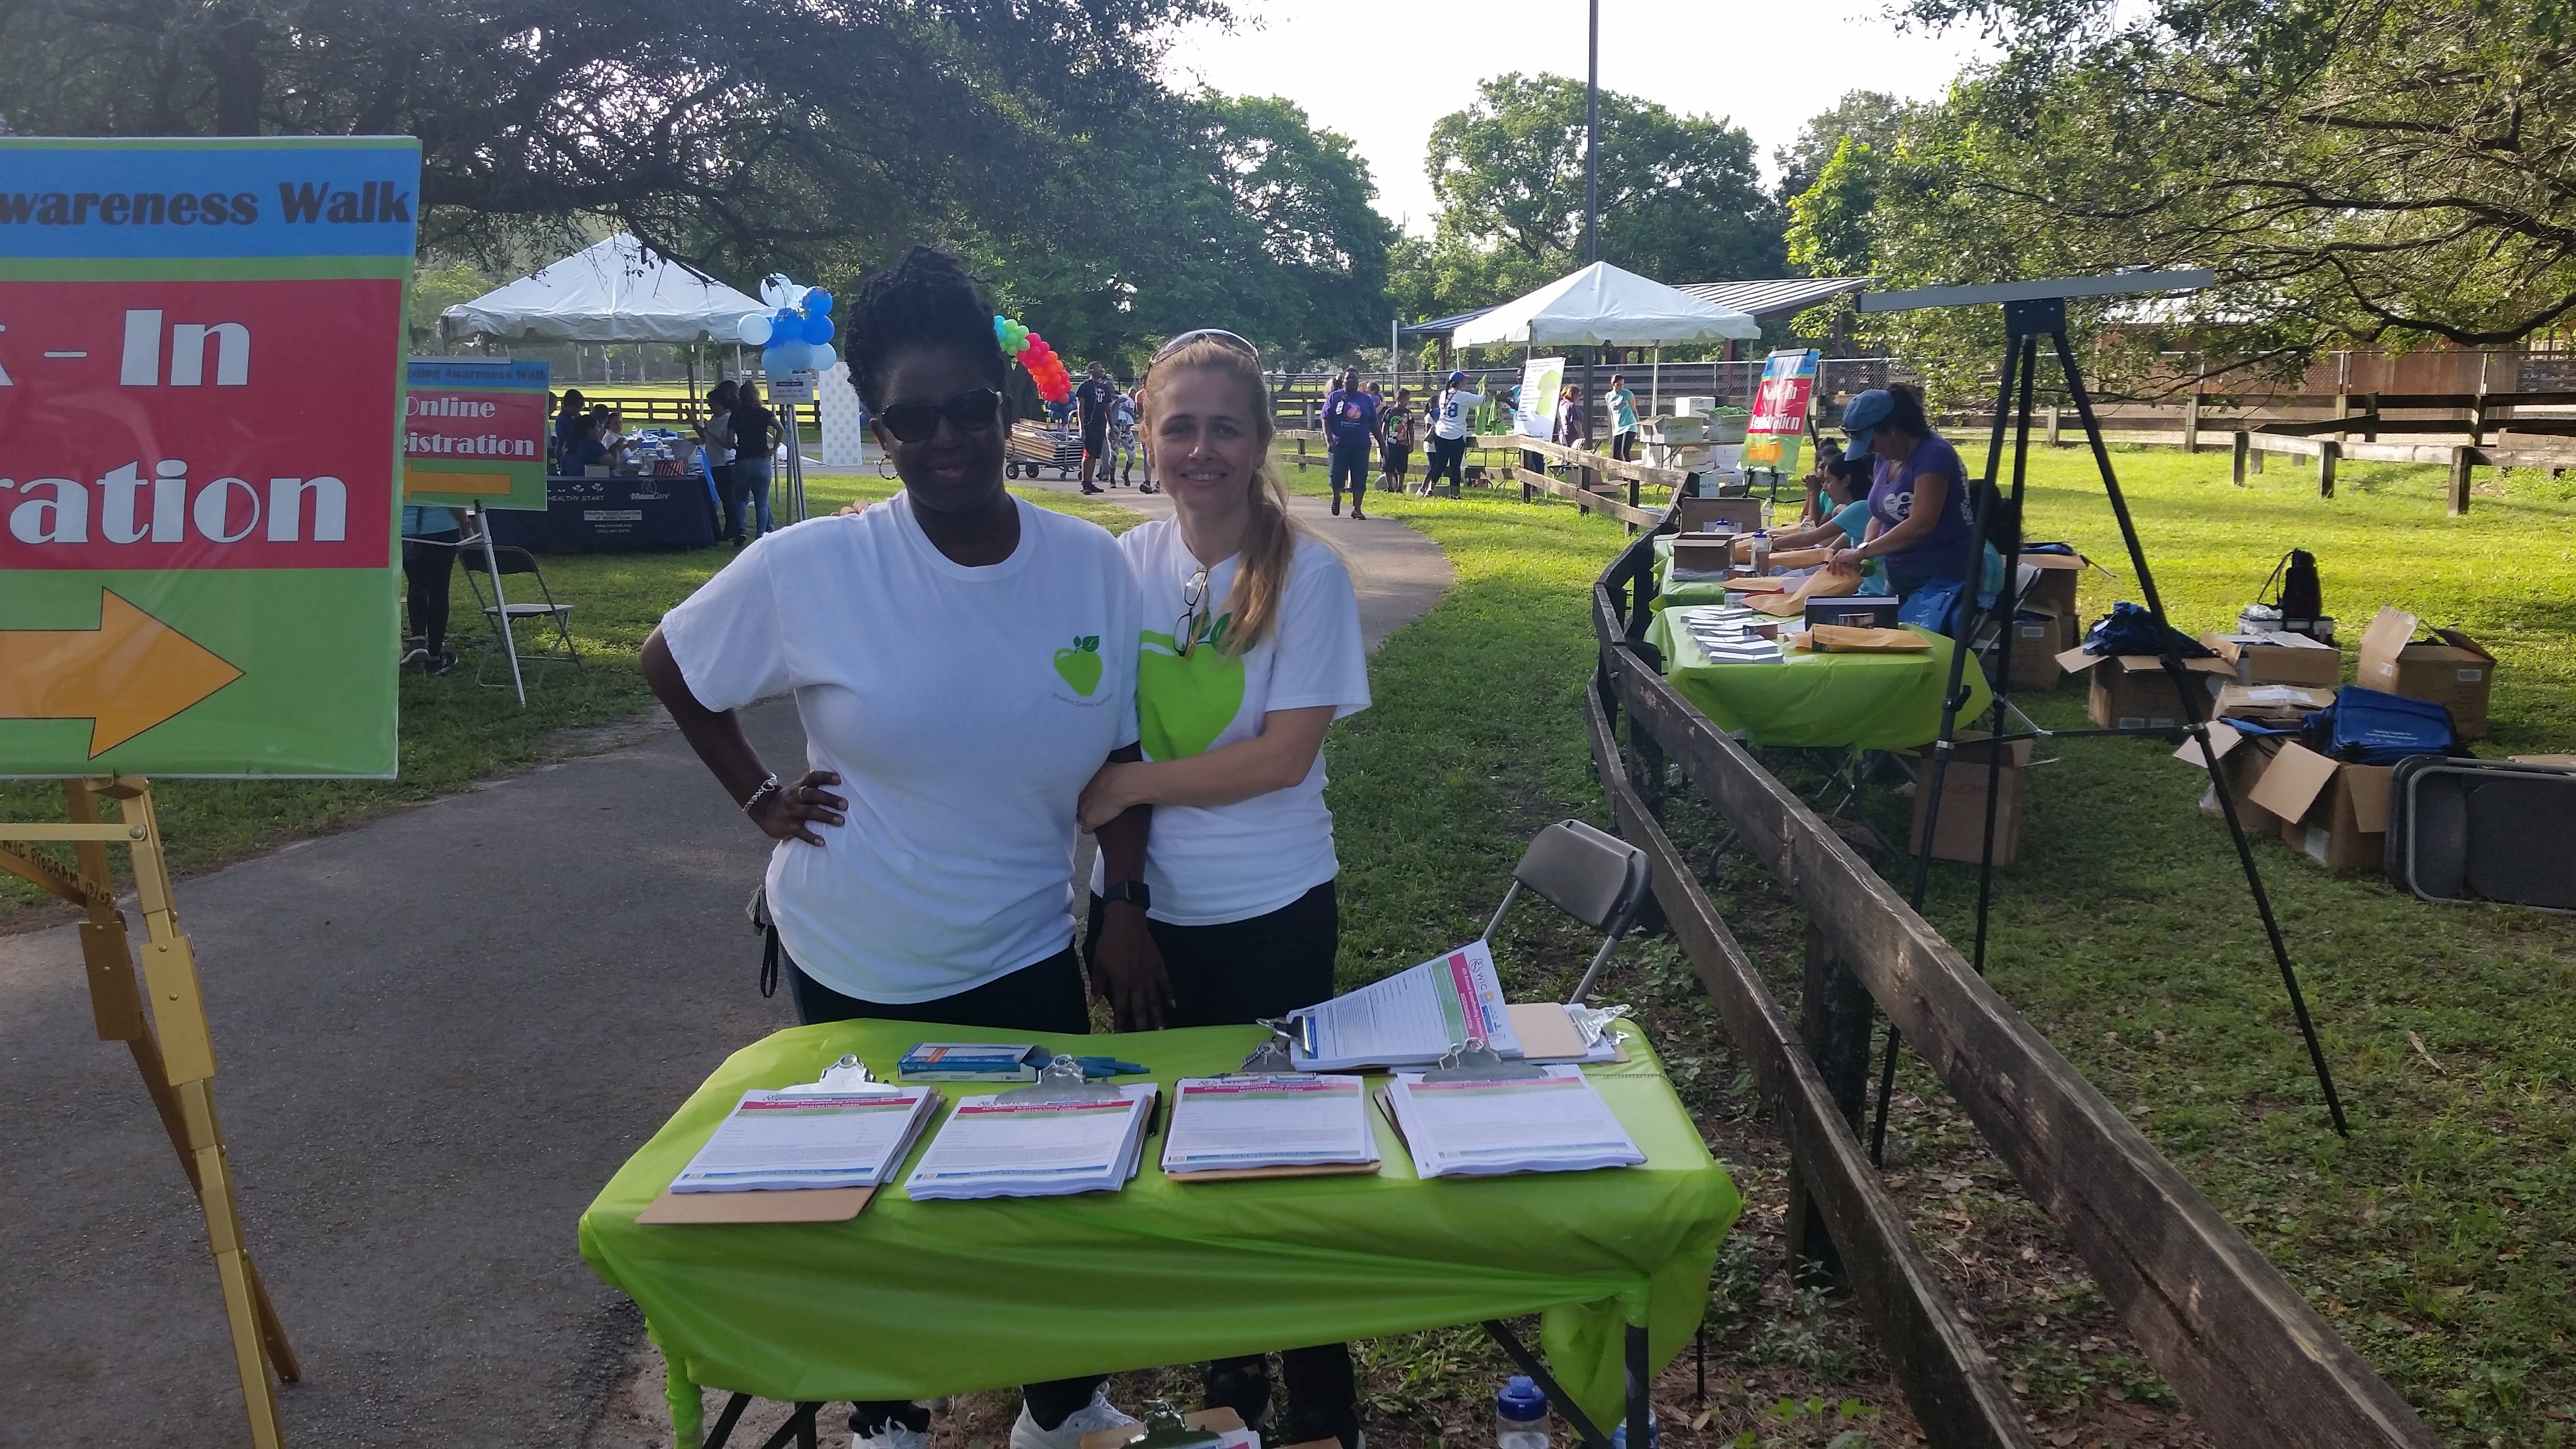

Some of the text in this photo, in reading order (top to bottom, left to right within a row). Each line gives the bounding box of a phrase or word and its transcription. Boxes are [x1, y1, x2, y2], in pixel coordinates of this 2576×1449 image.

[279, 181, 411, 224] Walk
[120, 308, 251, 386] In
[444, 368, 512, 380] Awareness
[516, 369, 547, 381] Walk
[405, 397, 496, 418] Online
[3, 840, 26, 858] WIC
[1477, 972, 1487, 990] WIC
